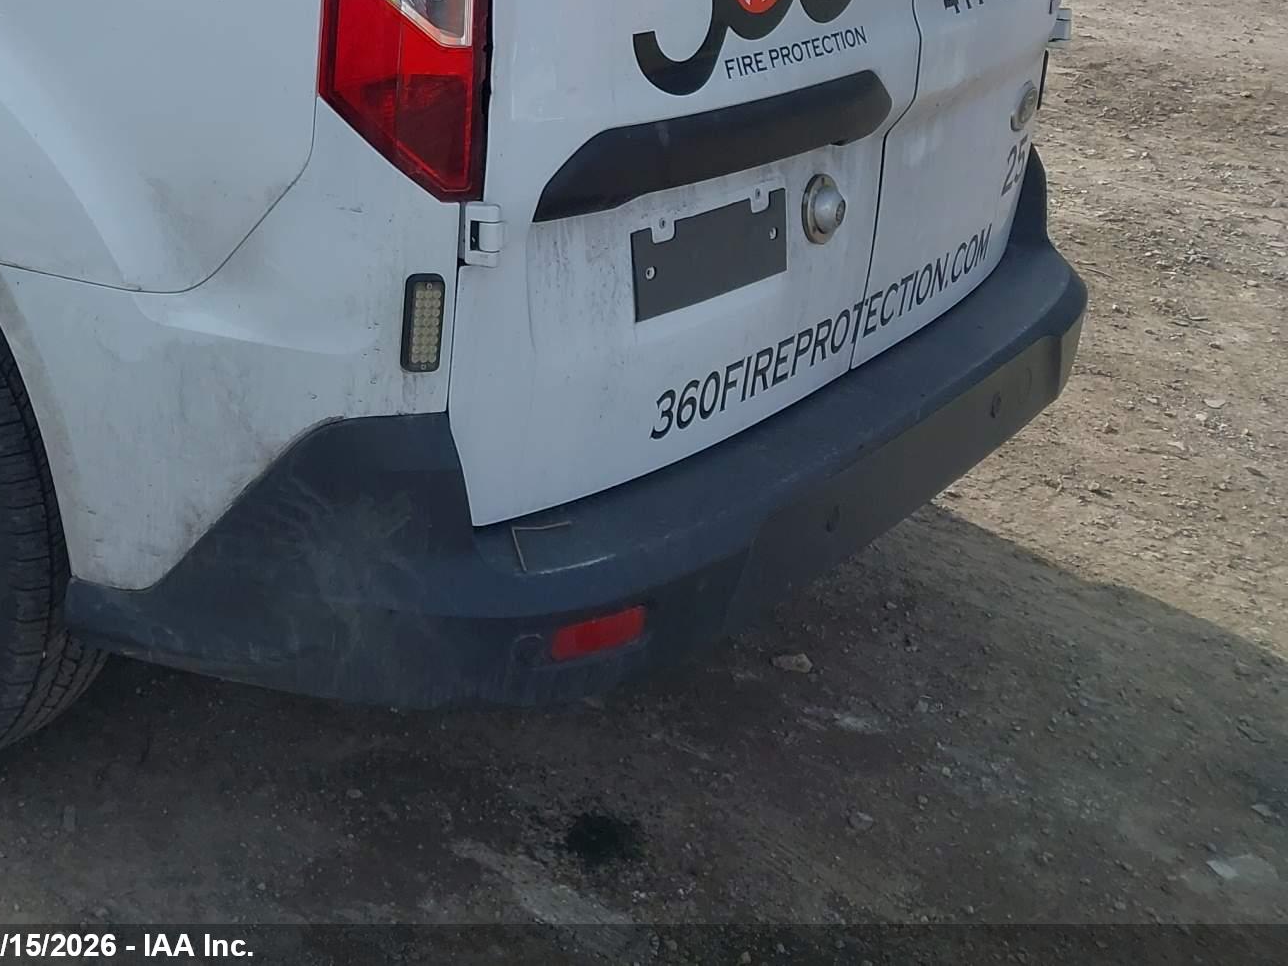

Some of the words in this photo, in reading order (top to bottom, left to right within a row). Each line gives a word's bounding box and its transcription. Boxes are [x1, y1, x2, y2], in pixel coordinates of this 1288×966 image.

[724, 51, 768, 80] FIRE
[769, 25, 868, 69] PROTECTION
[1001, 133, 1029, 196] 25
[650, 223, 993, 440] 360FIREPROTECTION.COM
